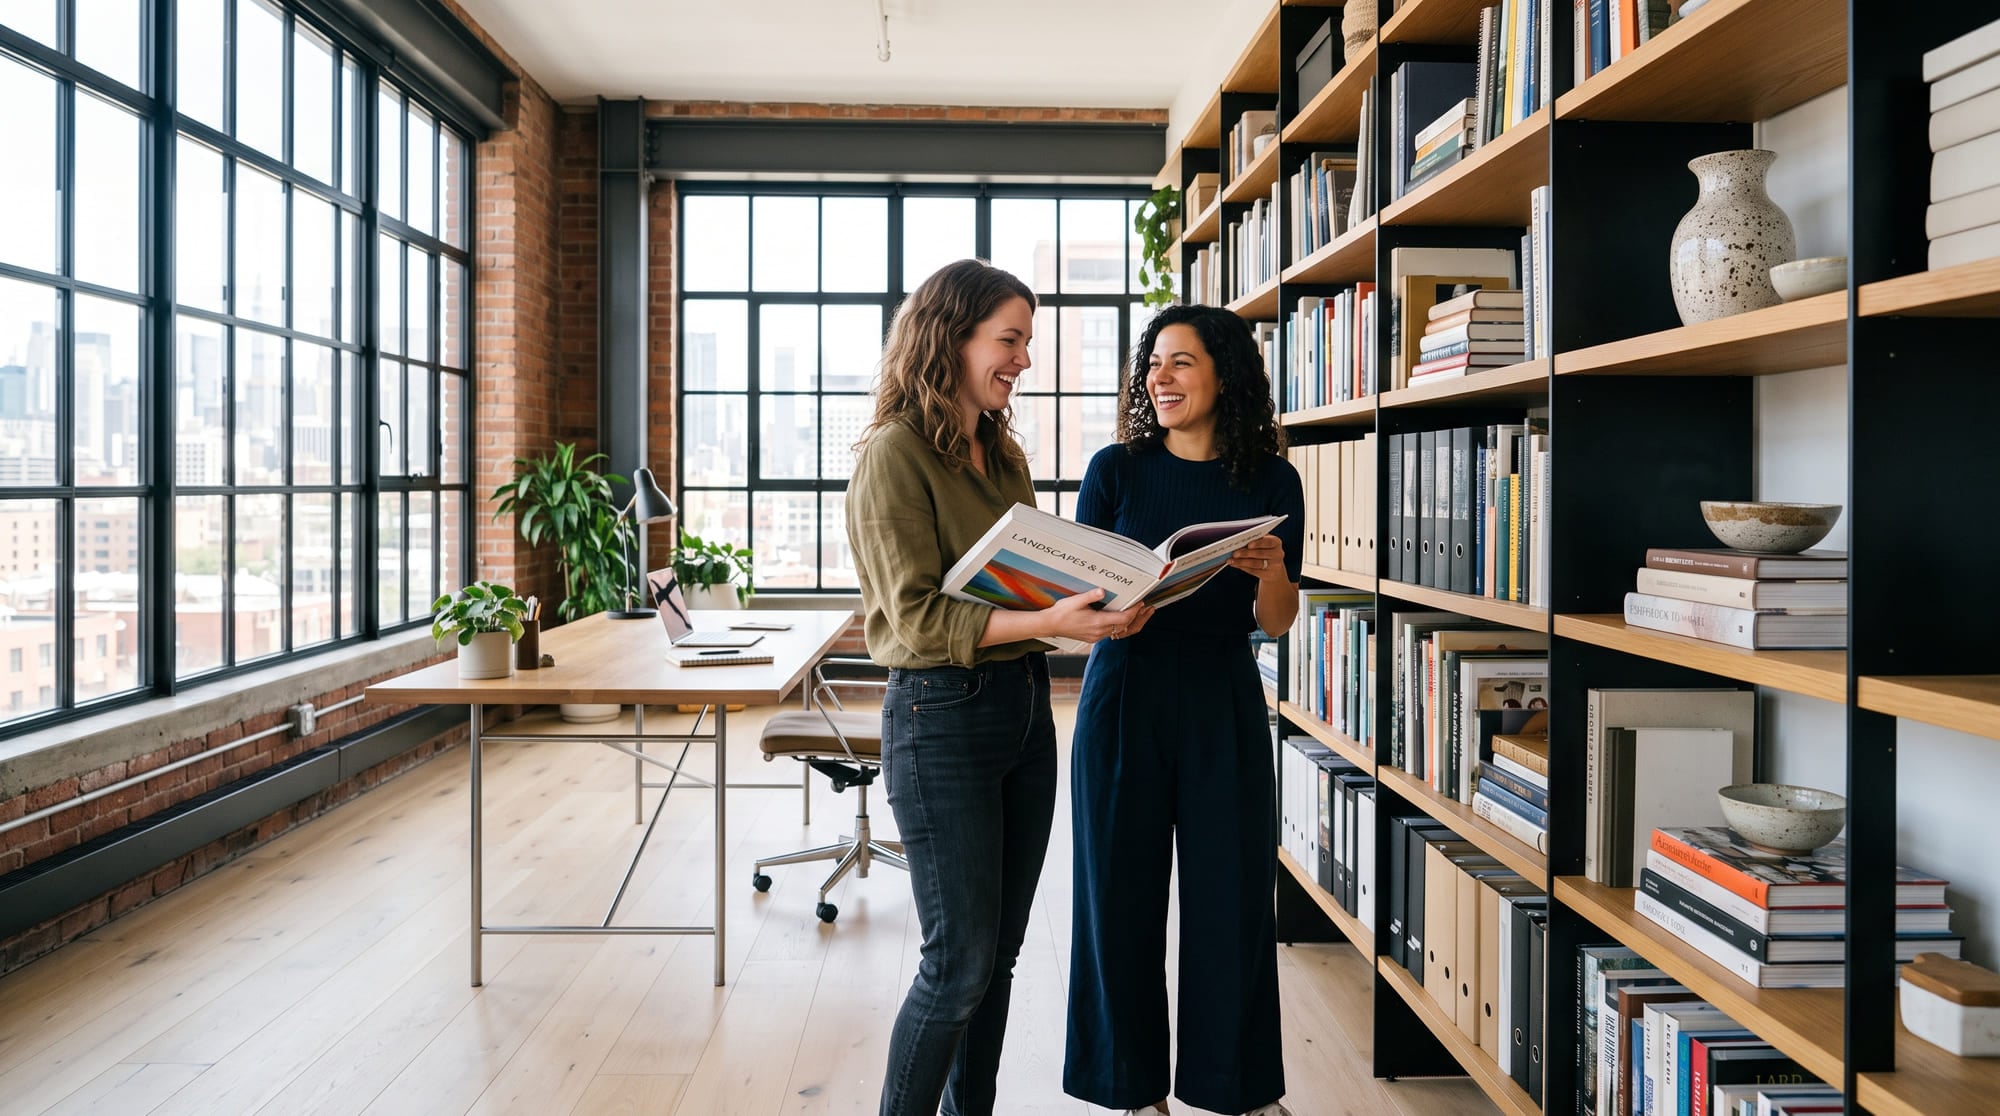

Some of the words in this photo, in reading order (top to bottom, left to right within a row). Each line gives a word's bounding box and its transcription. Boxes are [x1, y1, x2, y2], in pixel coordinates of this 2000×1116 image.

[1011, 533, 1088, 567] LANDSCAPES
[1087, 564, 1097, 572] &
[1098, 568, 1134, 587] FORM
